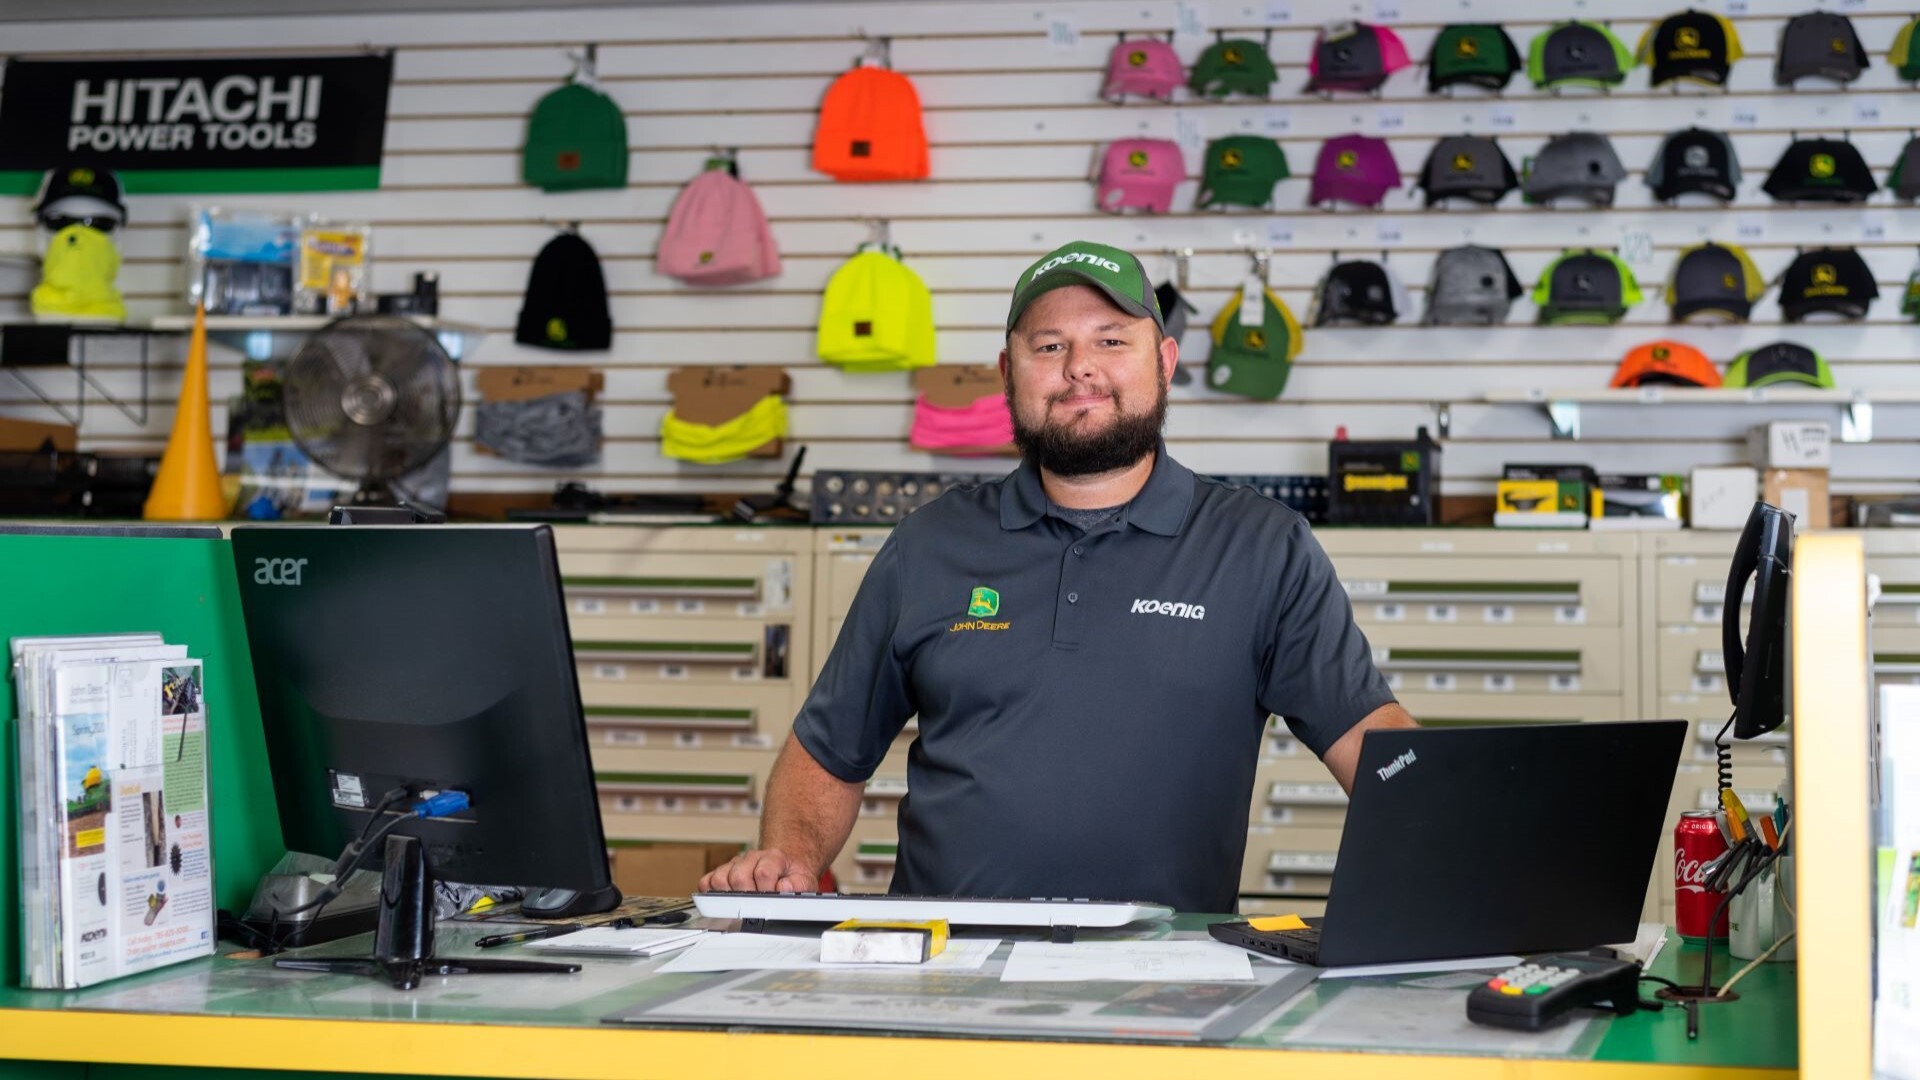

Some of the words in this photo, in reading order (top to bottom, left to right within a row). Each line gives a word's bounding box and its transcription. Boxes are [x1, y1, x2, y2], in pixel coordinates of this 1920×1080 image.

[71, 75, 322, 124] HITACHI
[68, 123, 195, 151] POWER
[202, 121, 317, 150] TOOLS
[254, 557, 308, 586] acer
[950, 621, 976, 632] JOHN
[977, 620, 1010, 631] DEERE
[1376, 748, 1417, 781] ThinkPad
